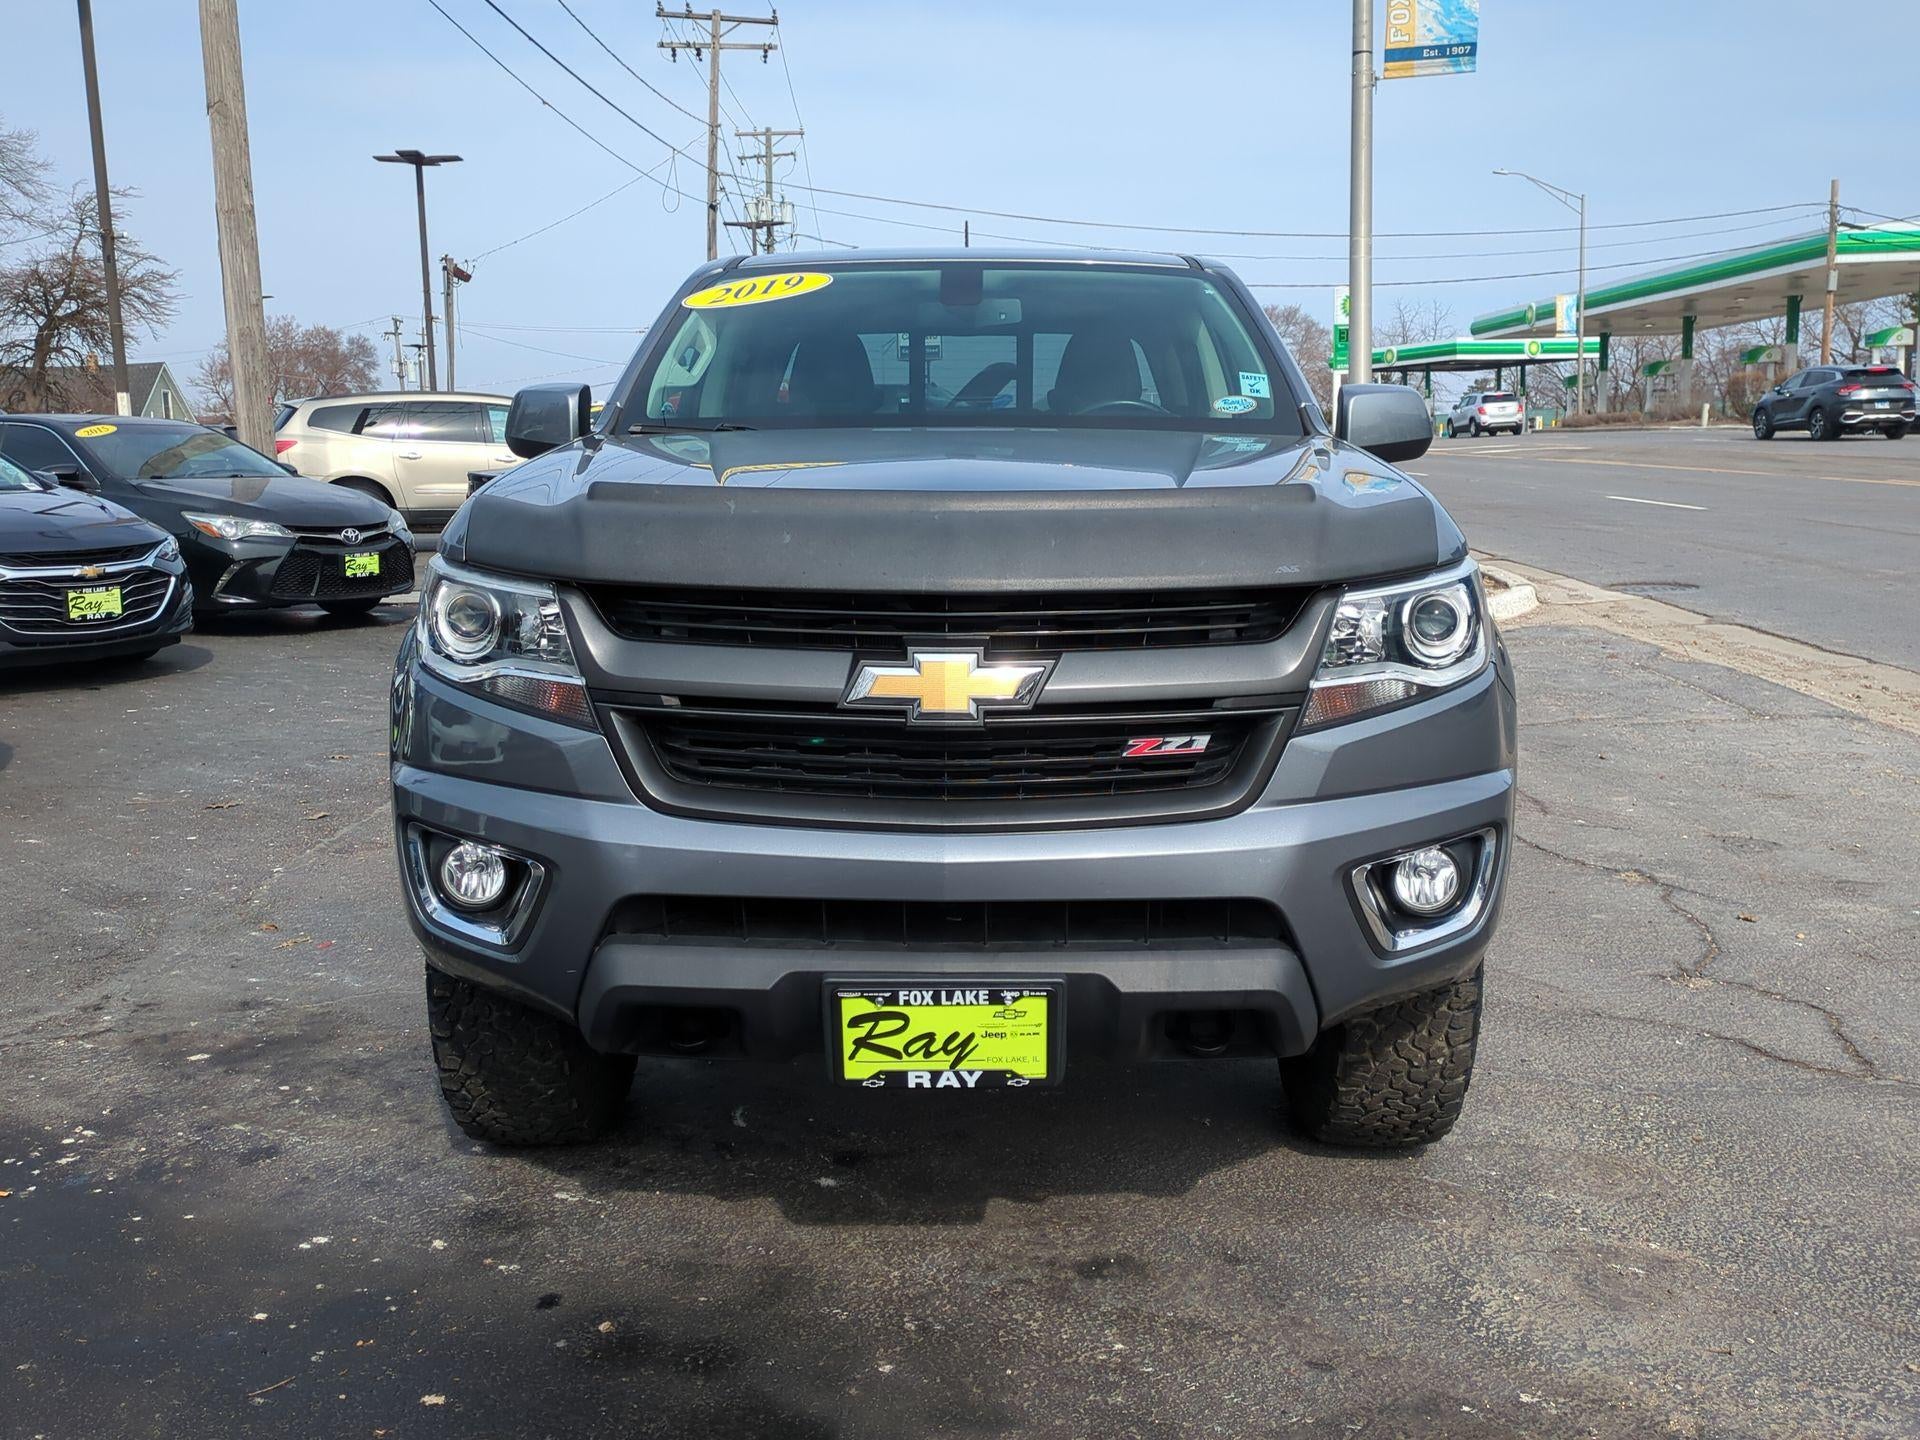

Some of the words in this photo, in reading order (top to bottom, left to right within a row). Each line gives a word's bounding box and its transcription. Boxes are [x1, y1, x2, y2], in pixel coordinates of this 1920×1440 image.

[1423, 48, 1442, 57] Est.
[1446, 45, 1472, 55] 1907
[708, 274, 805, 304] 2019
[345, 559, 368, 572] Ray
[70, 596, 103, 613] Ray
[1122, 735, 1211, 757] Z71
[898, 990, 934, 1006] FOX
[941, 990, 990, 1005] LAKE
[847, 1011, 979, 1070] Ray
[980, 1030, 1007, 1040] Jeep
[1005, 1056, 1029, 1064] LAKE,
[907, 1070, 984, 1089] RAY
